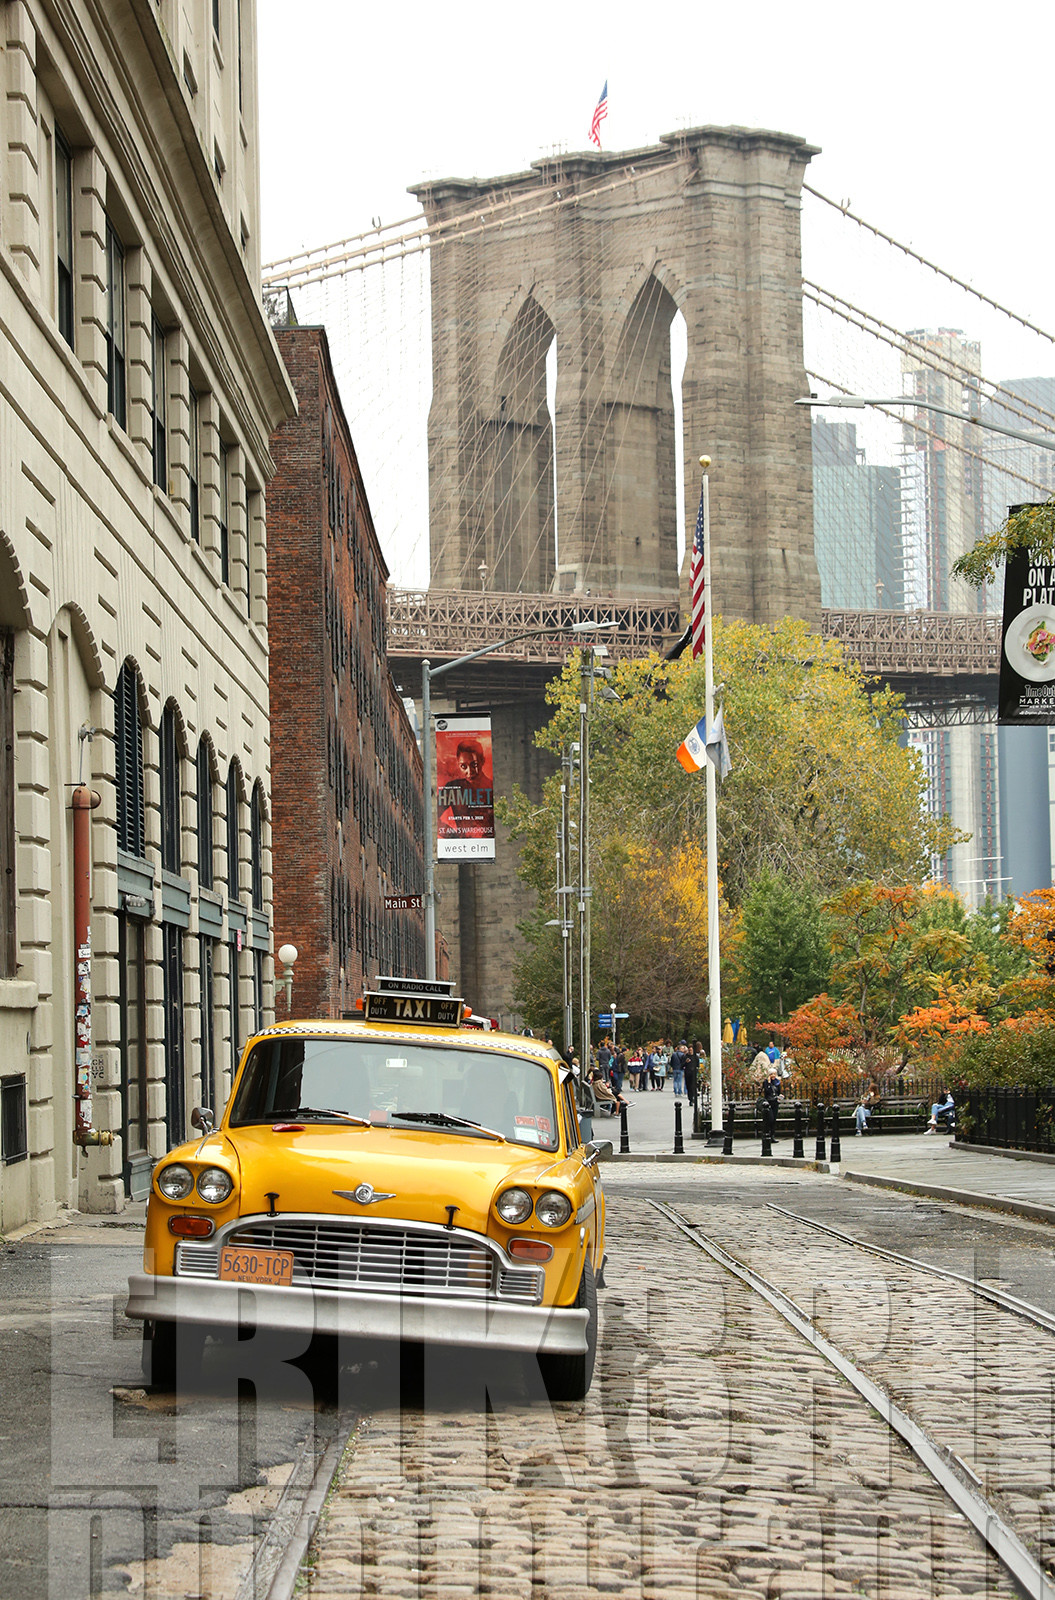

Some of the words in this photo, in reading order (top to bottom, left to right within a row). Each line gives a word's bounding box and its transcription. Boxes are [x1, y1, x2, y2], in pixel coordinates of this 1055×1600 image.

[1028, 568, 1045, 587] ON
[438, 788, 492, 806] HAMLET
[470, 844, 489, 852] elm
[385, 898, 407, 908] Main
[410, 898, 420, 908] St
[401, 983, 424, 991] RADIO
[425, 984, 442, 992] CALL
[374, 997, 387, 1005] OFF
[393, 1000, 431, 1018] TAXI
[440, 1002, 454, 1010] OFF
[370, 1007, 388, 1015] DUTY
[437, 1012, 455, 1020] DUTY
[224, 1253, 289, 1276] 5630-TCP
